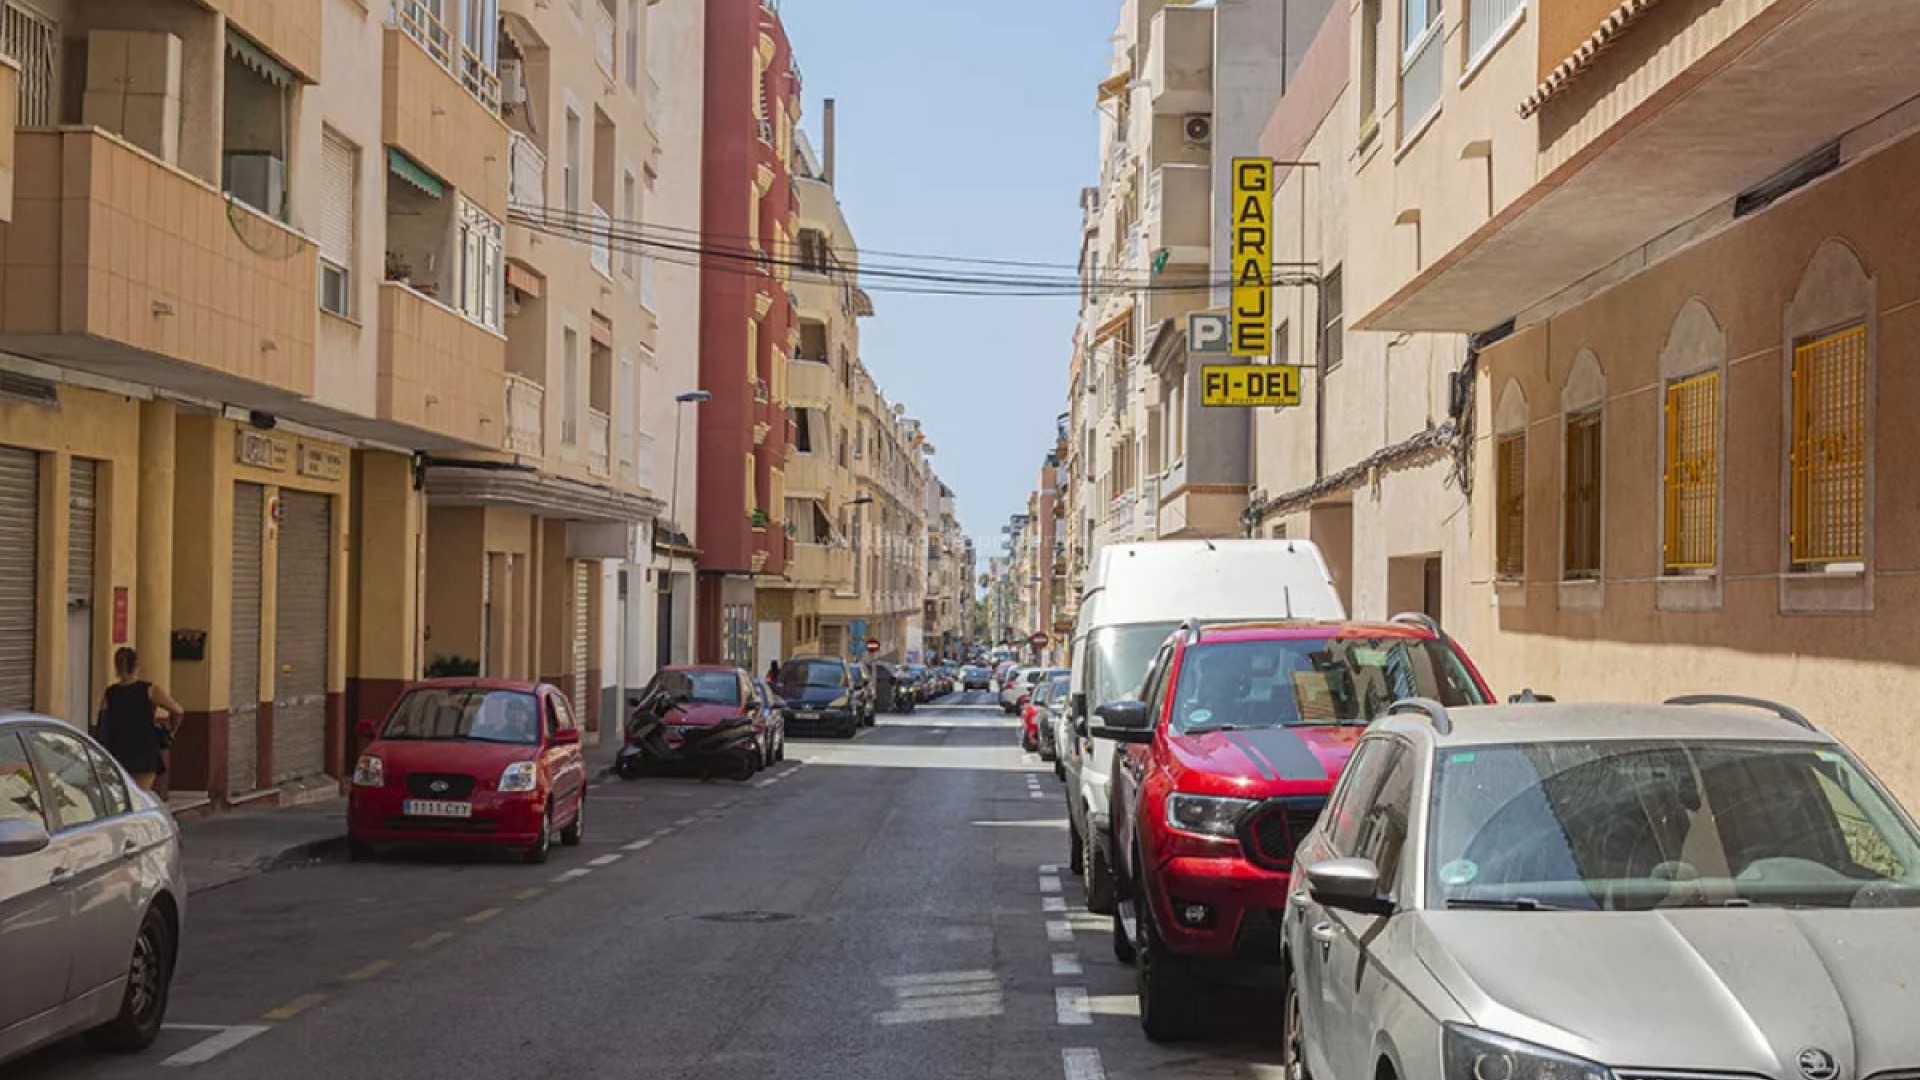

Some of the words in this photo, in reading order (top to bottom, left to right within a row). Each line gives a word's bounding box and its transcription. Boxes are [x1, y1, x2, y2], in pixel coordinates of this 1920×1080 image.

[1238, 164, 1266, 349] GARAJE
[1194, 316, 1222, 349] P
[1207, 372, 1297, 397] FI-DEL
